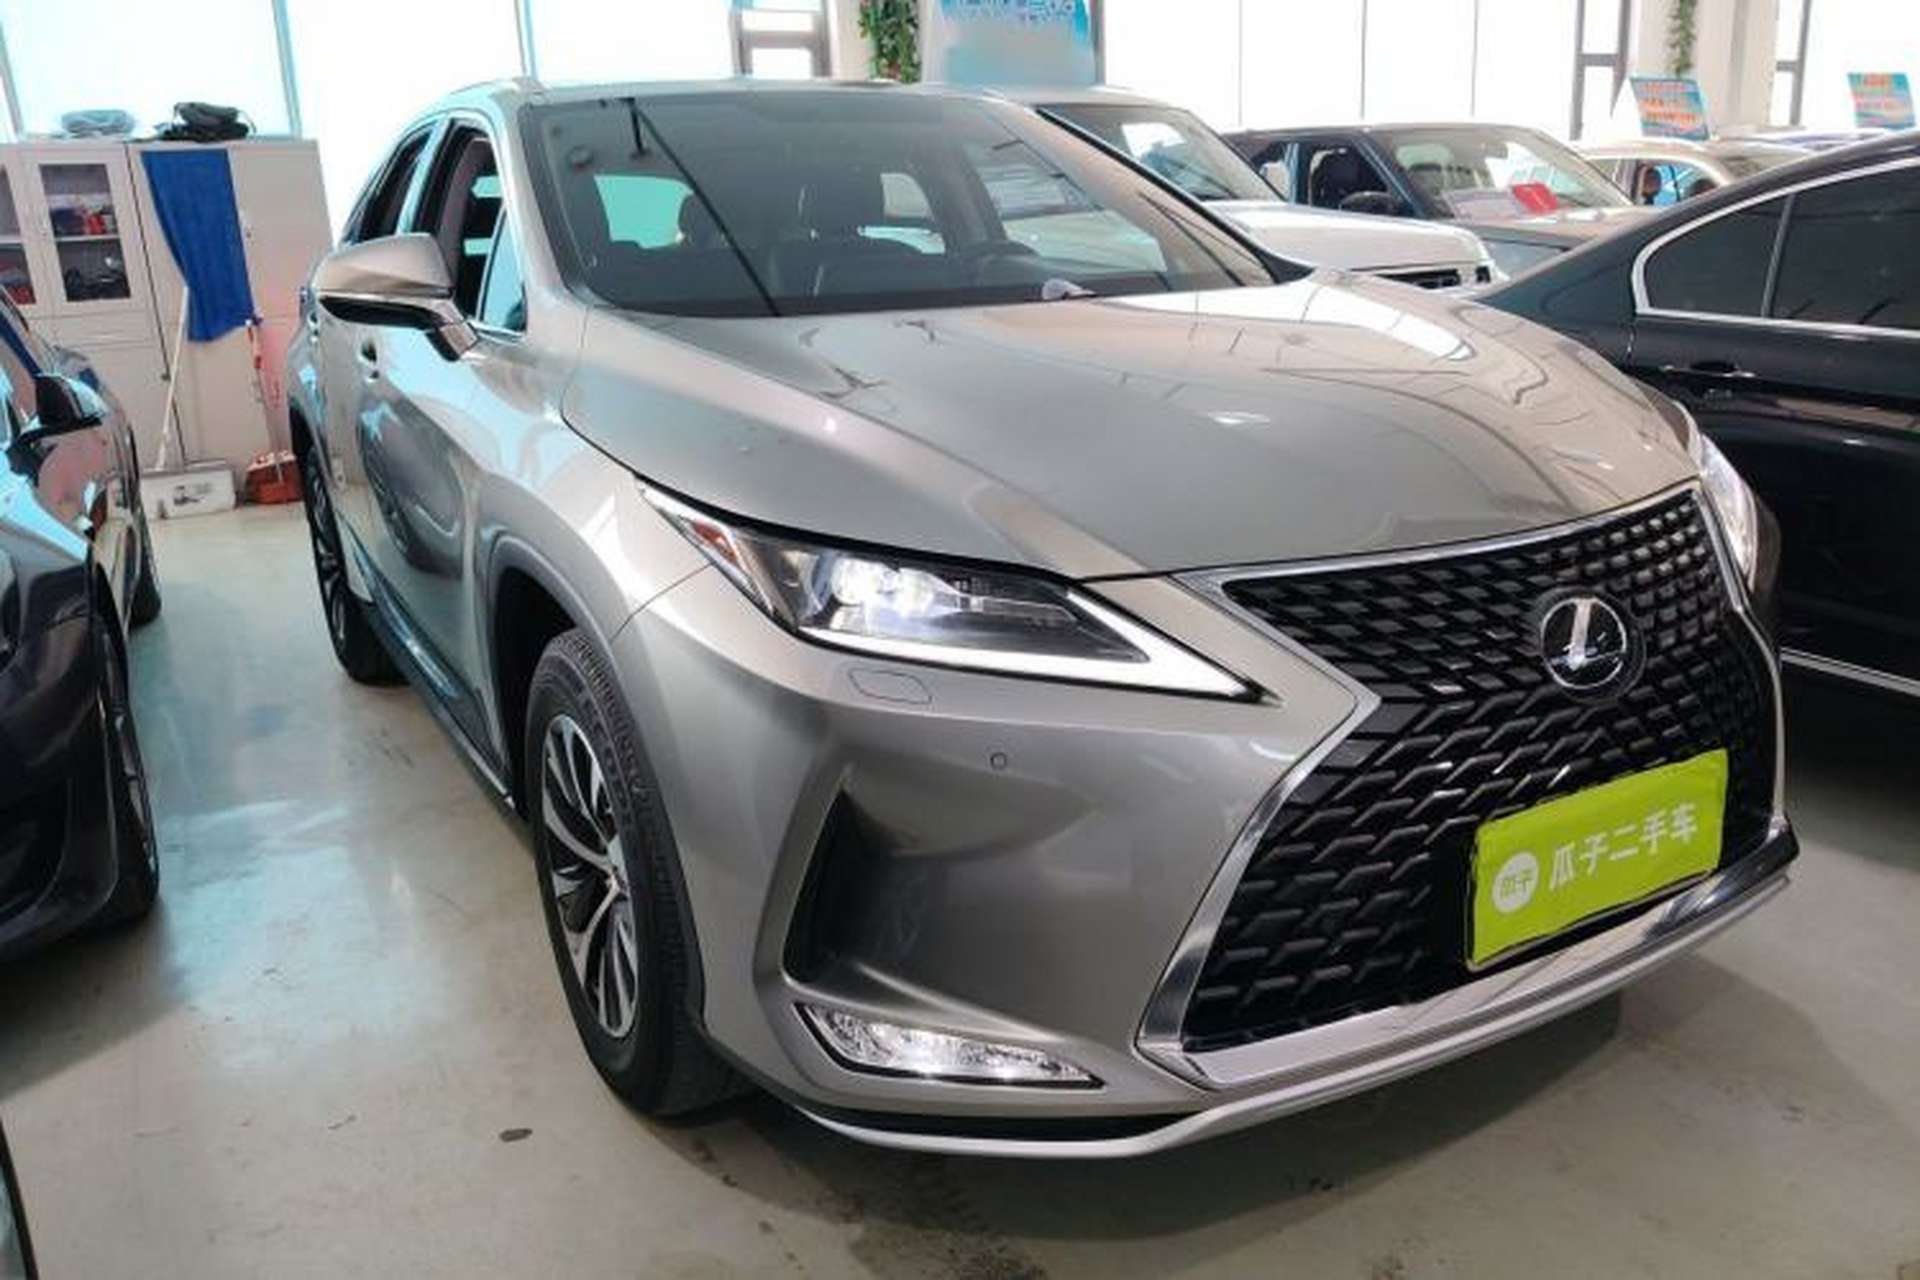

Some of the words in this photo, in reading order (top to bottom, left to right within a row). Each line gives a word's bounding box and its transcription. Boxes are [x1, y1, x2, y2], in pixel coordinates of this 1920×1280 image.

[1549, 802, 1698, 890] 瓜子二手车
